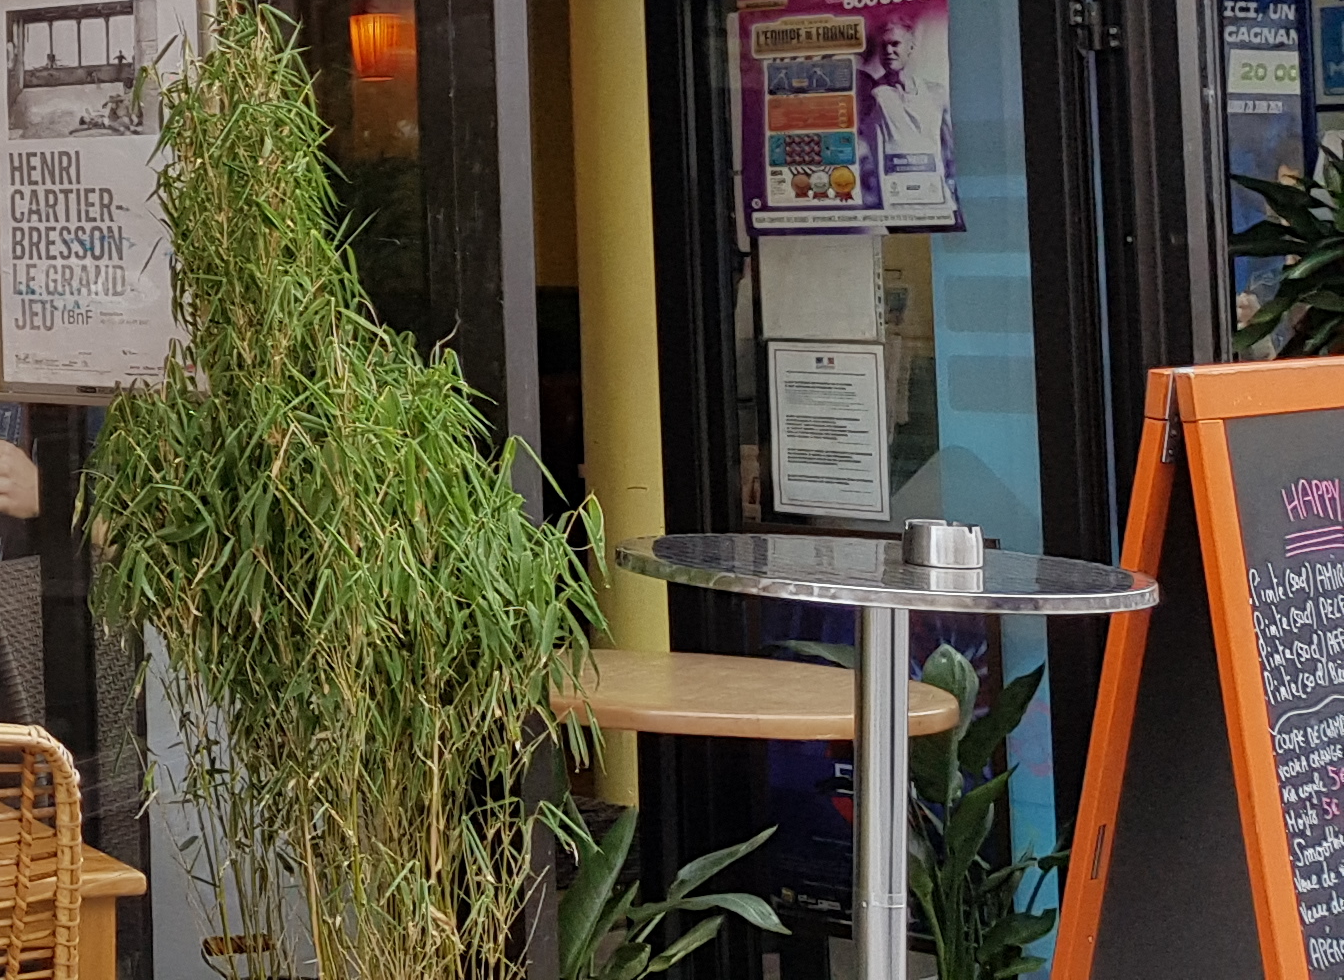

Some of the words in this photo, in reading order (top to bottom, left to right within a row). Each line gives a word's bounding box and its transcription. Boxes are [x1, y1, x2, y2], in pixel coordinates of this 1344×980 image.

[8, 150, 81, 187] HENRI
[10, 187, 124, 224] CARTIER-
[11, 225, 124, 261] BRESSON
[44, 263, 127, 297] GRAND
[14, 298, 55, 331] JEU
[1280, 478, 1343, 522] HAPPY
